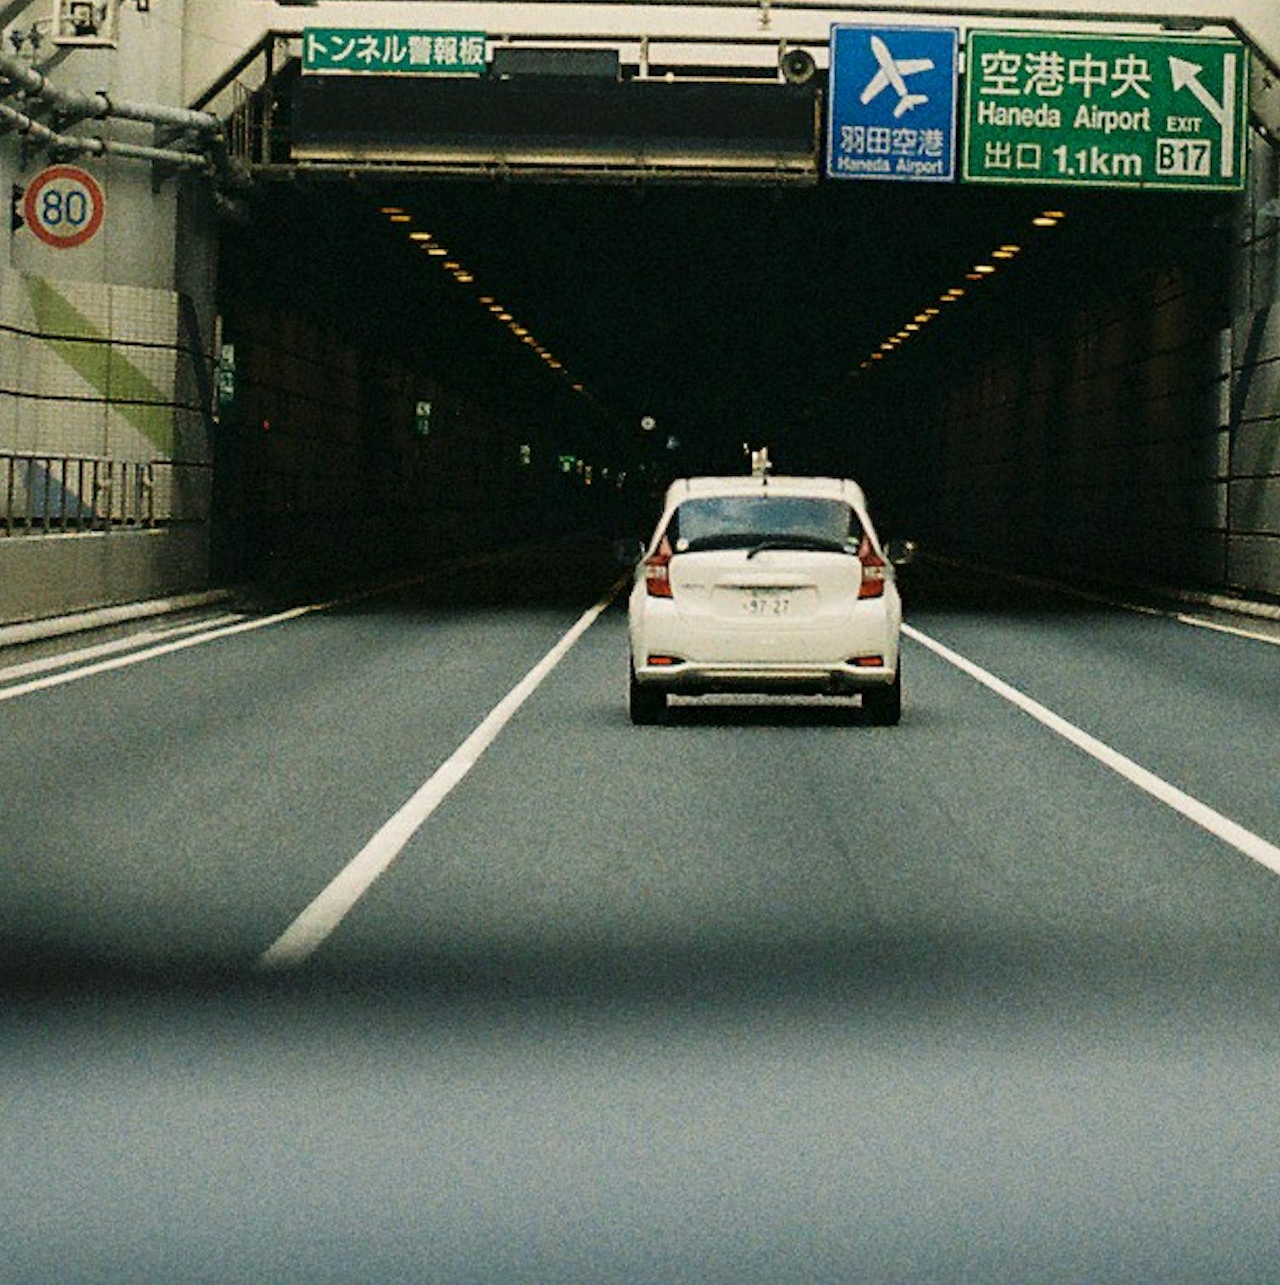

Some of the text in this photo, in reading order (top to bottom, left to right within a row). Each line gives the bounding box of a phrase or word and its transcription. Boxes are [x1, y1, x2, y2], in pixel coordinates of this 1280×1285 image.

[307, 33, 484, 66] トンネル警報板
[979, 49, 1153, 99] 空港中央
[977, 100, 1151, 134] Haneda Airport
[1166, 116, 1202, 133] EXIT
[840, 125, 944, 157] 羽田空港
[984, 141, 1043, 171] 出口
[837, 155, 944, 175] Haneda Airport
[1159, 142, 1208, 173] B17
[43, 189, 87, 226] 80
